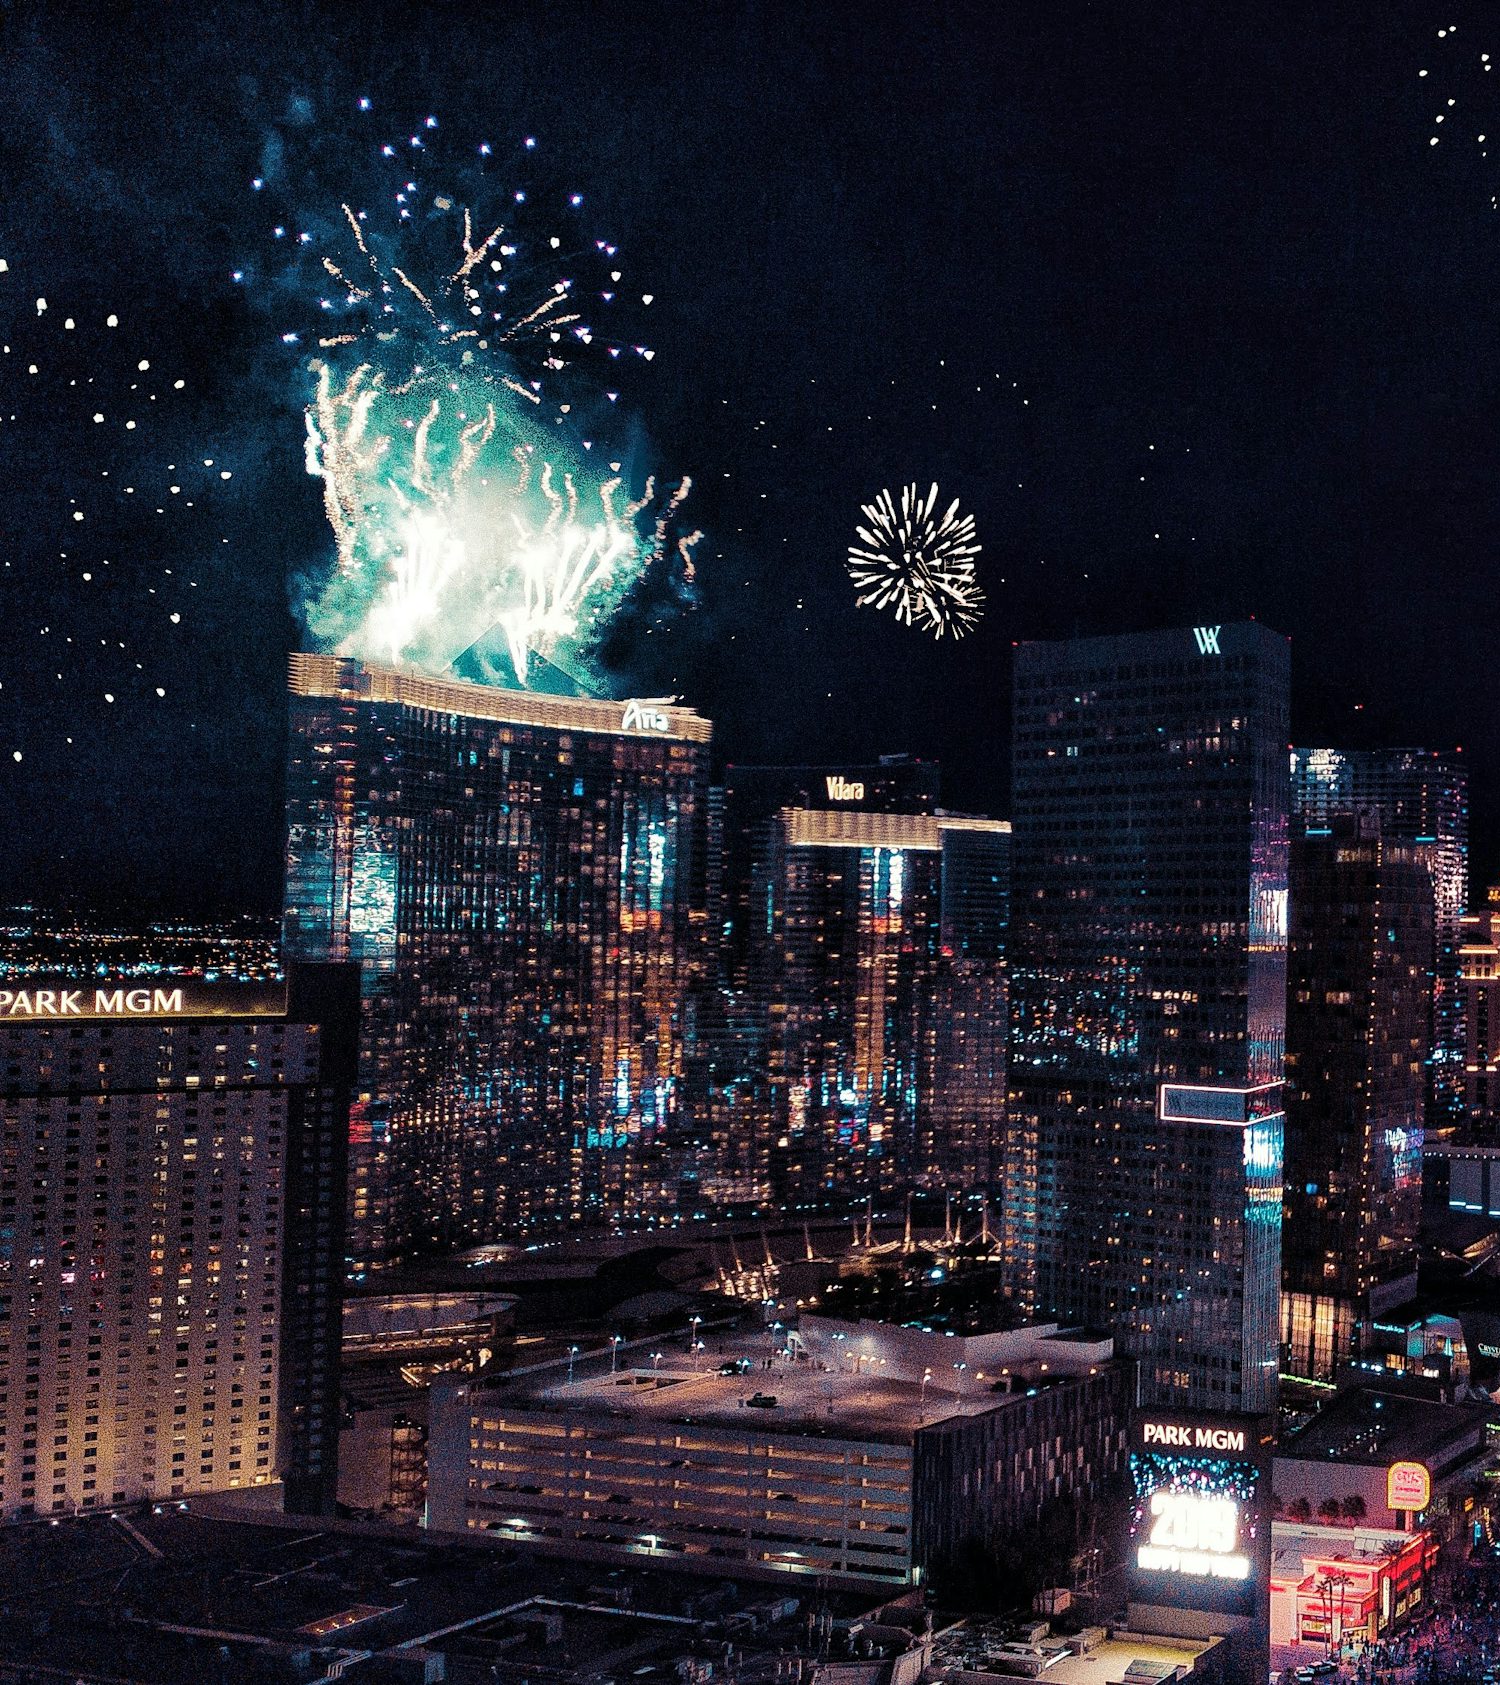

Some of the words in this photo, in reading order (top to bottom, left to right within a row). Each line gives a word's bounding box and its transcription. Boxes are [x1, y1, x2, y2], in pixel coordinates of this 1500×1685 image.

[621, 700, 669, 731] Aria
[826, 776, 864, 800] Vdara
[0, 990, 82, 1014] PARK
[95, 989, 182, 1012] MGM
[1144, 1424, 1192, 1446] PARK
[1195, 1428, 1244, 1451] MGM
[1150, 1490, 1238, 1552] 2019
